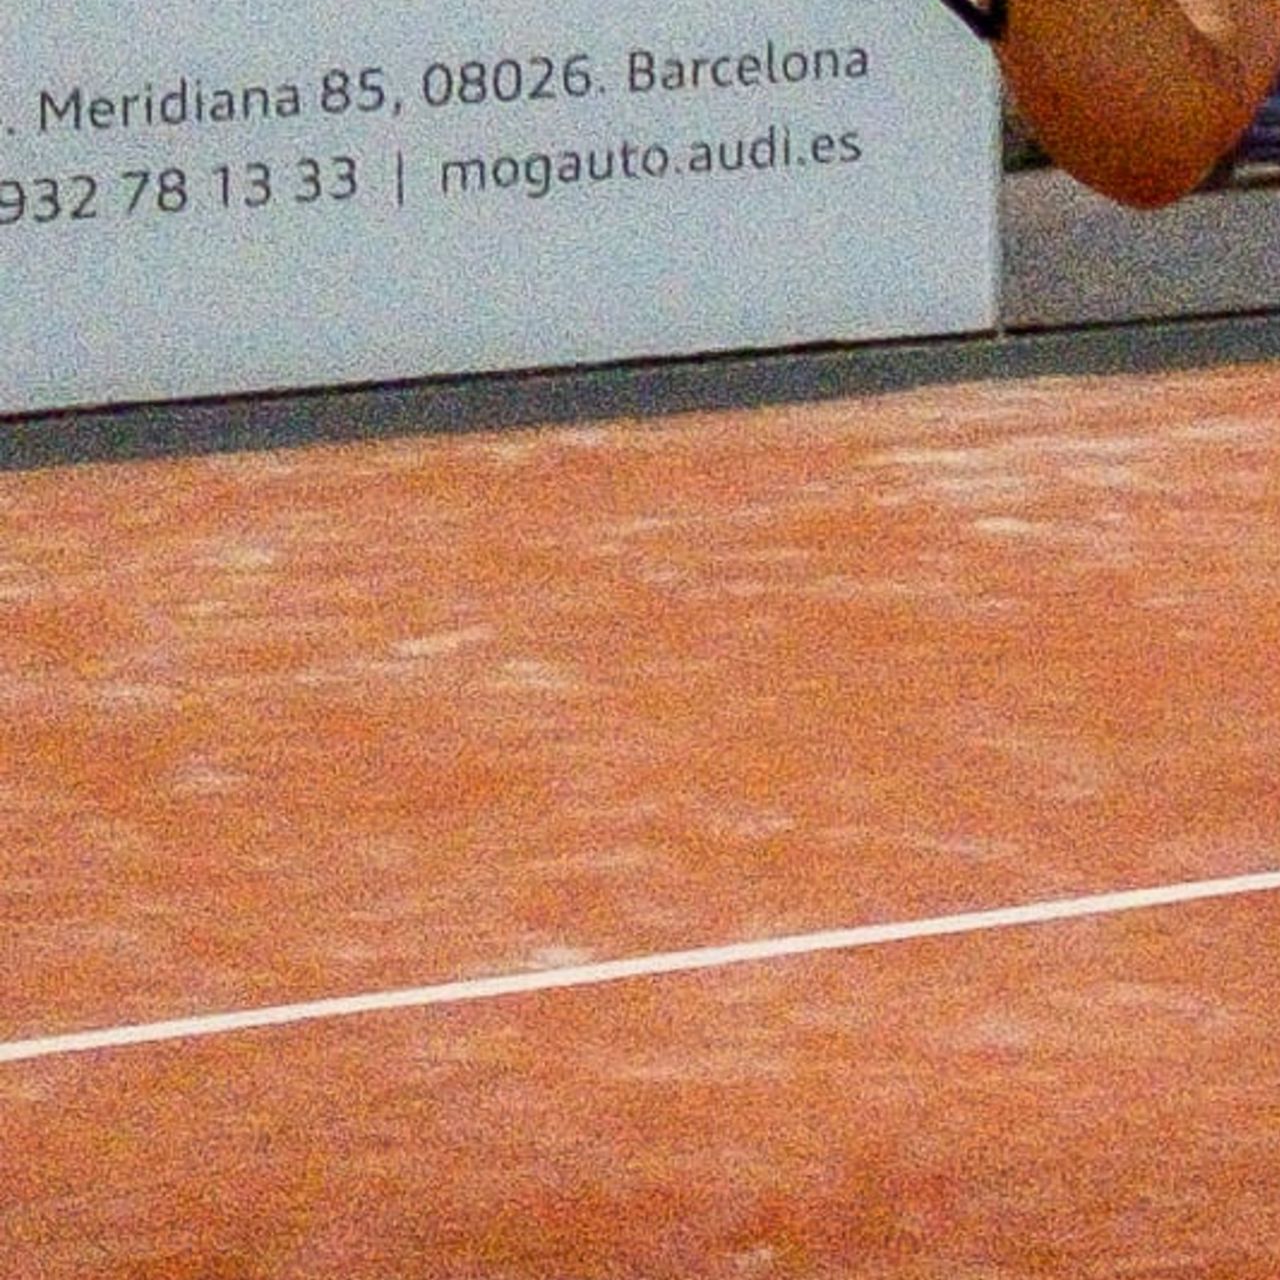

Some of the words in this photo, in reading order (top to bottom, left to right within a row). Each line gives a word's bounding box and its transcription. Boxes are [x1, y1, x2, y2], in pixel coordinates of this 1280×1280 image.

[38, 76, 302, 134] Meridiana
[320, 65, 404, 117] 85,
[421, 49, 607, 108] 08026.
[627, 40, 869, 94] Barcelona
[0, 174, 99, 227] 932
[122, 166, 189, 215] 78
[213, 161, 273, 209] 13
[294, 154, 358, 204] 33
[440, 124, 863, 200] mogauto.audi.es
